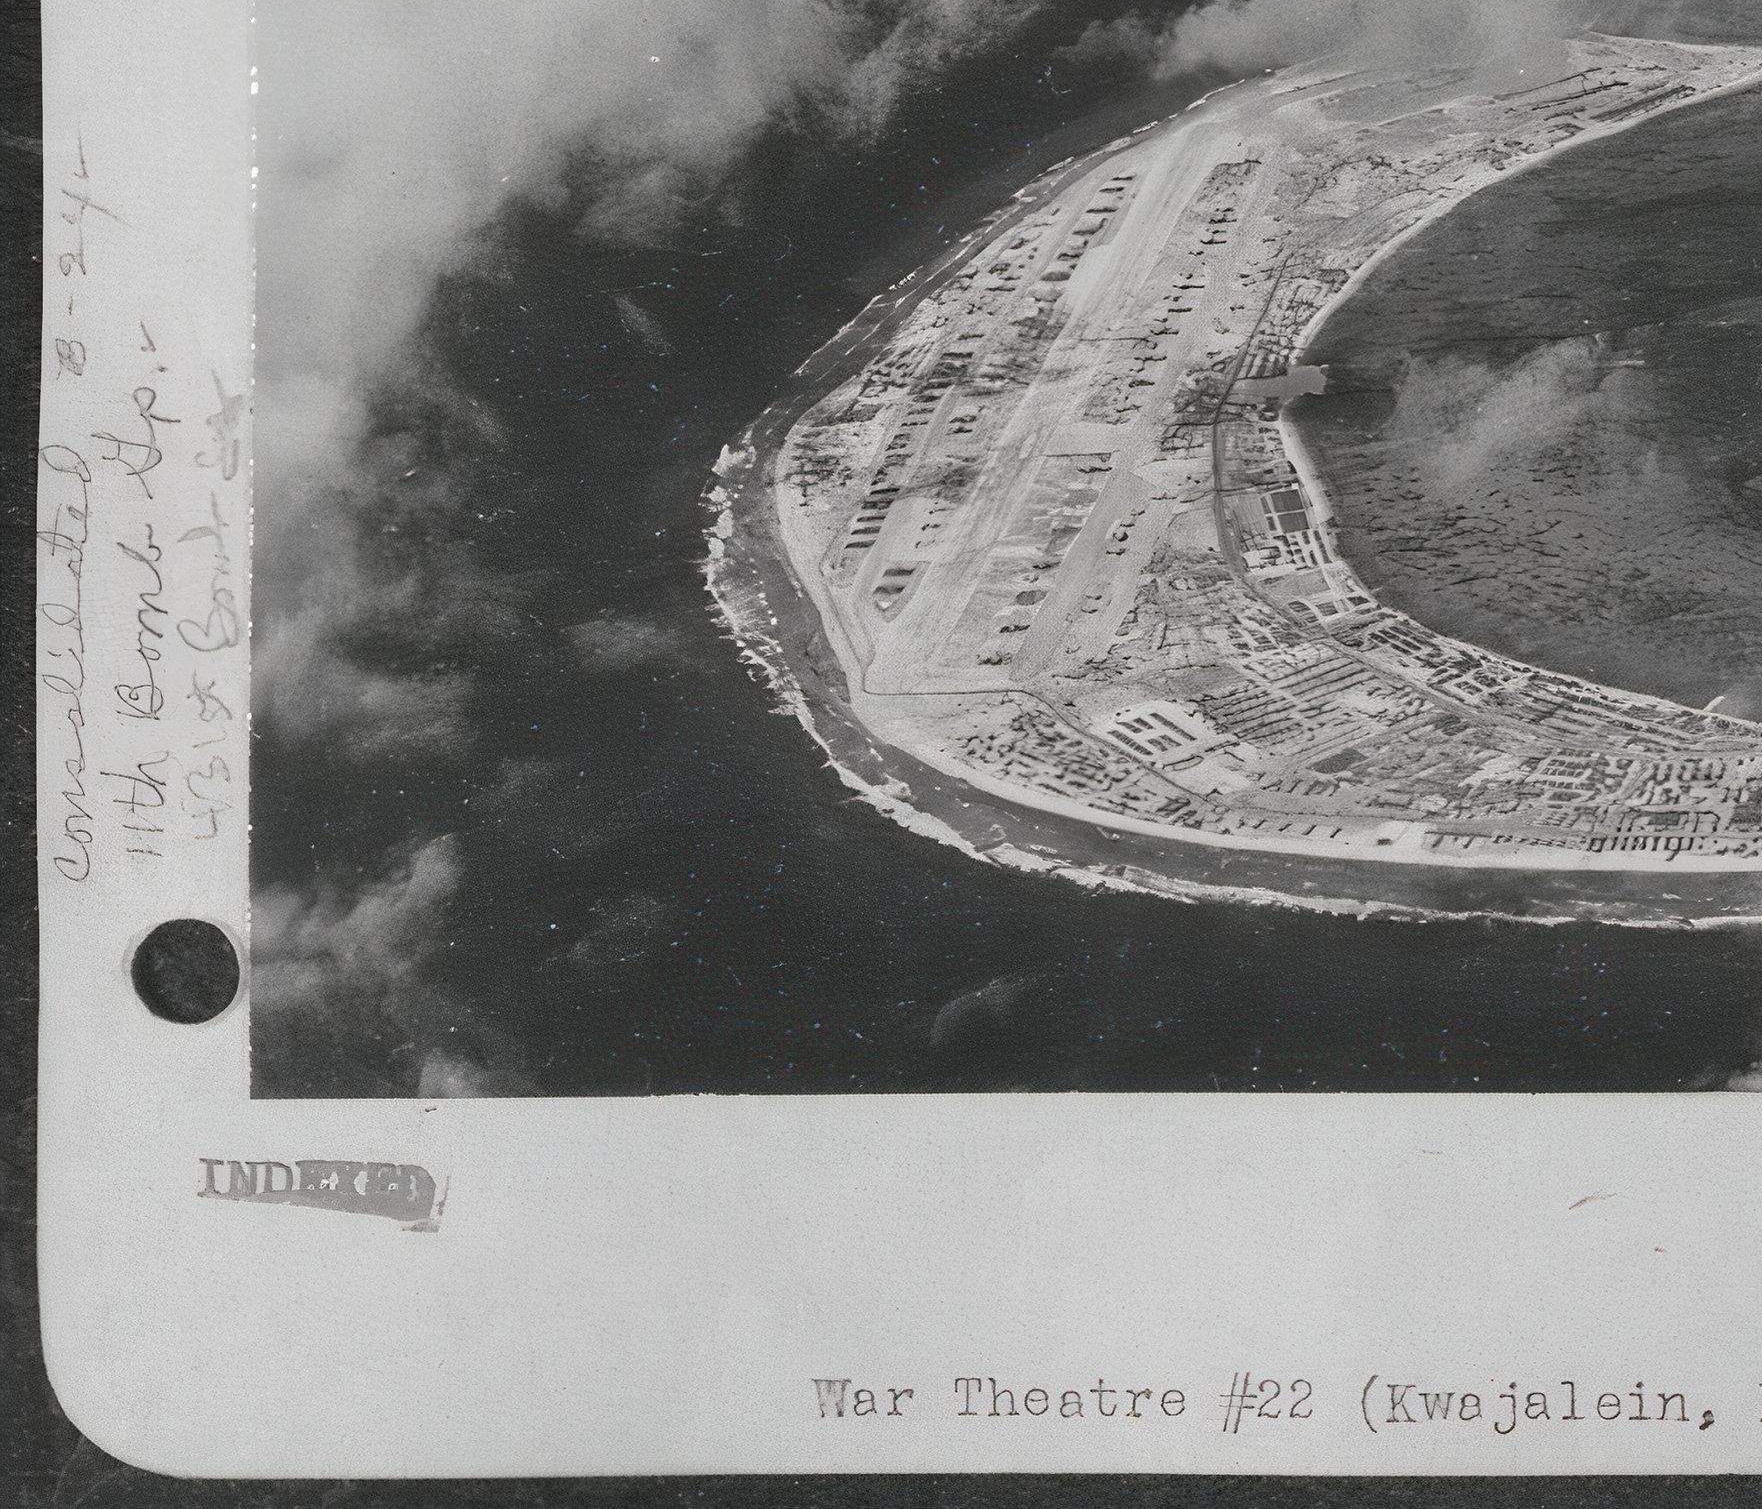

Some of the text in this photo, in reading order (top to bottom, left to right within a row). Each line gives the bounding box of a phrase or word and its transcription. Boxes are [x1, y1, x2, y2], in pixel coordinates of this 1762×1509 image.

[113, 523, 168, 720] Bomb
[100, 750, 169, 857] 11th
[812, 1378, 914, 1419] War
[955, 1377, 1186, 1419] Theatre
[1221, 1371, 1314, 1435] #22
[1361, 1374, 1716, 1436] (Kwajalein,
